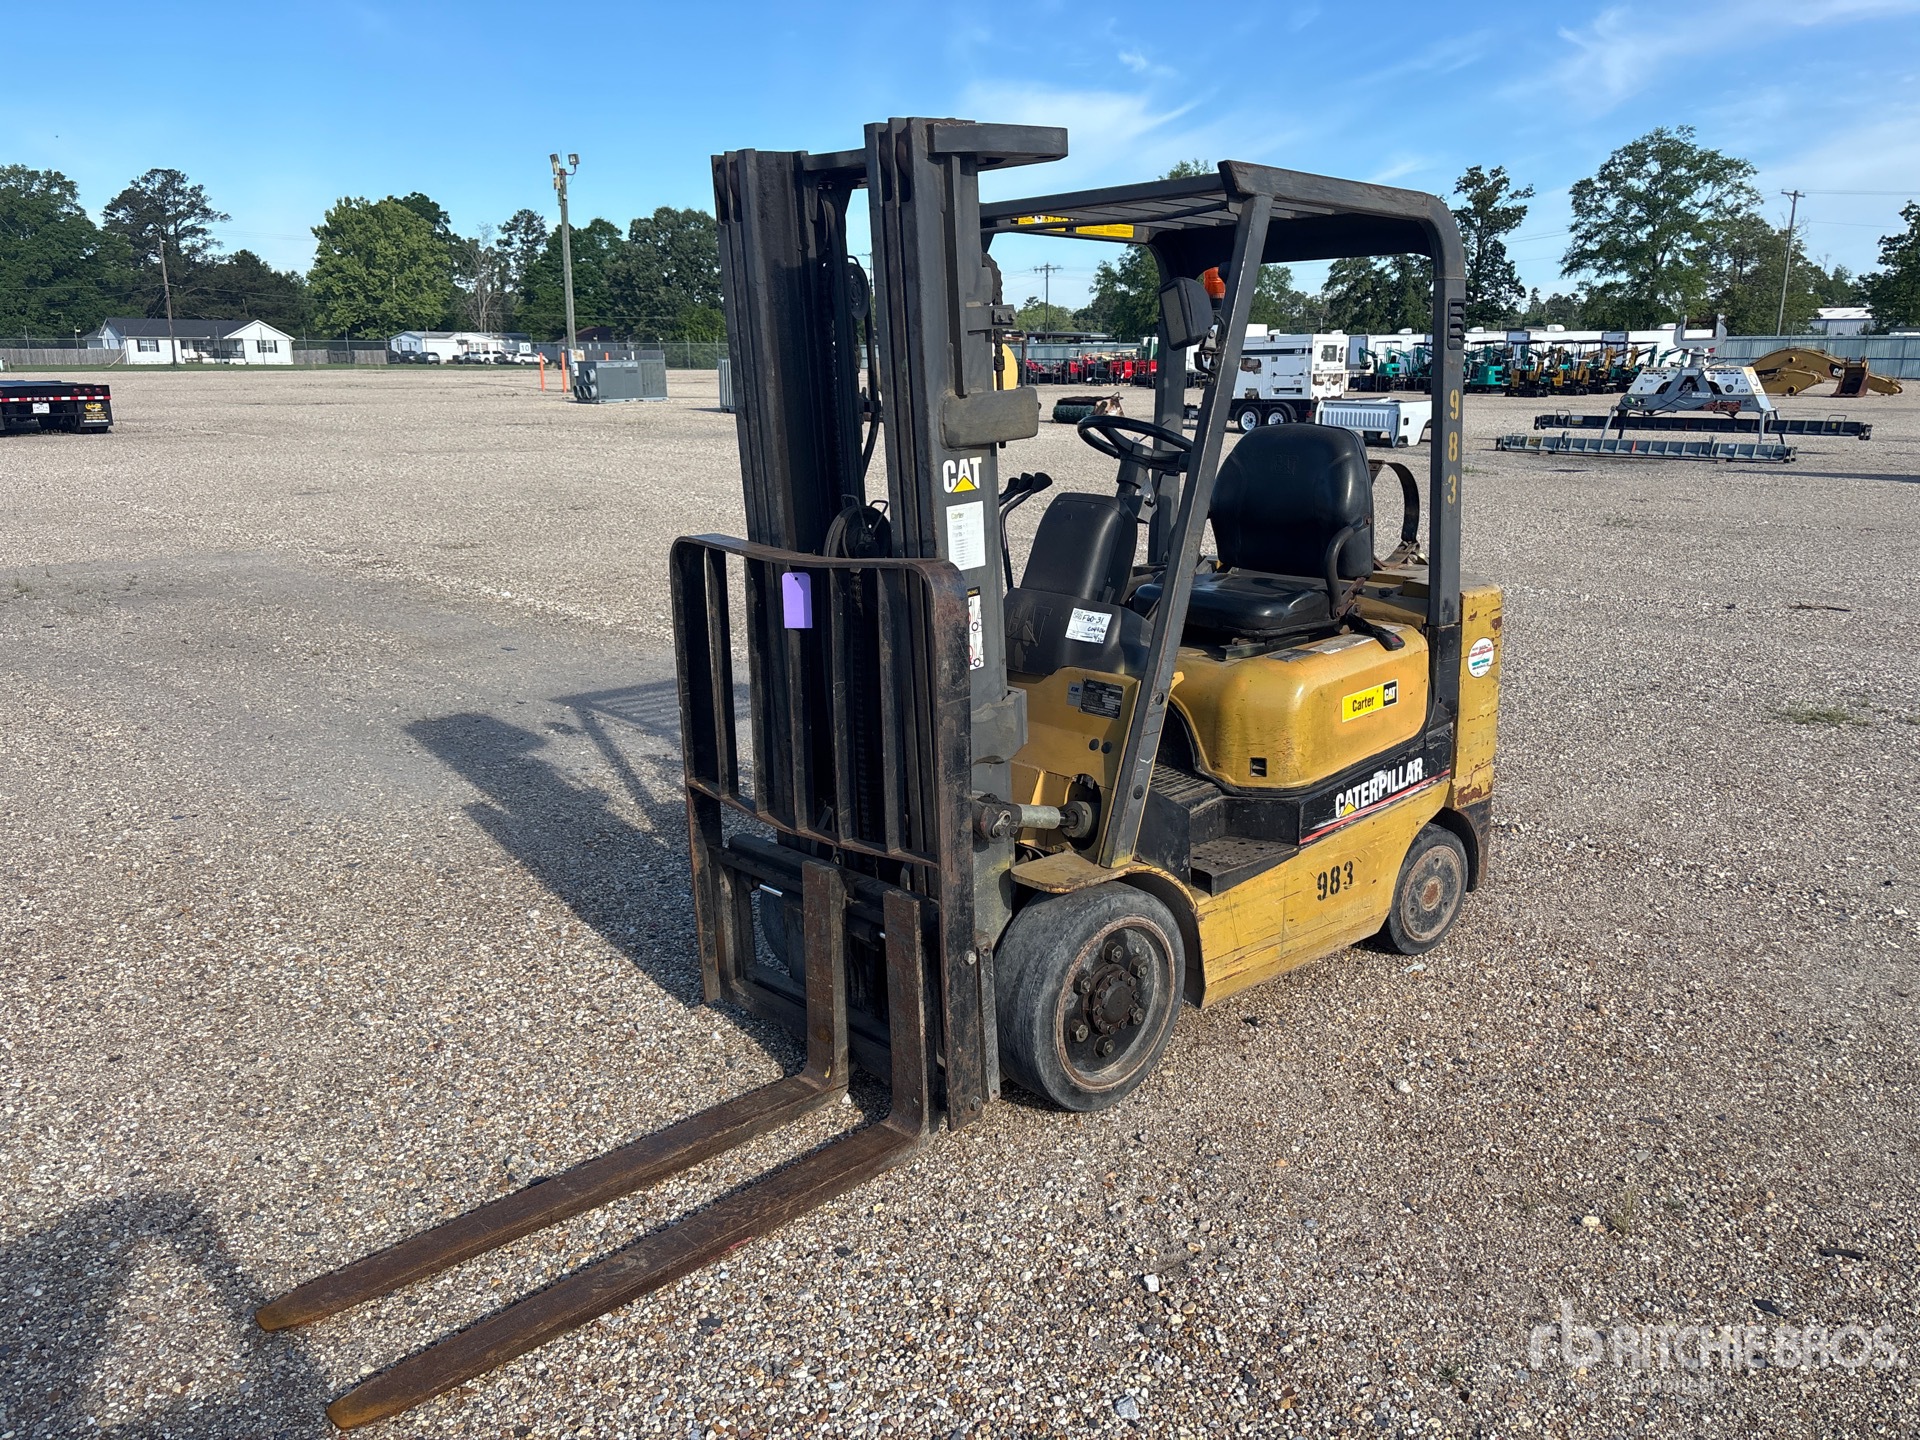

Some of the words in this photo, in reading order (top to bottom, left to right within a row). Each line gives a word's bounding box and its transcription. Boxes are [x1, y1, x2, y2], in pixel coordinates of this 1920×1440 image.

[1447, 389, 1459, 504] 983
[942, 457, 982, 493] CAT
[1352, 696, 1375, 712] Carter
[1384, 687, 1396, 701] CAT
[1336, 757, 1423, 818] CATERPILLAR
[1317, 861, 1354, 901] 983
